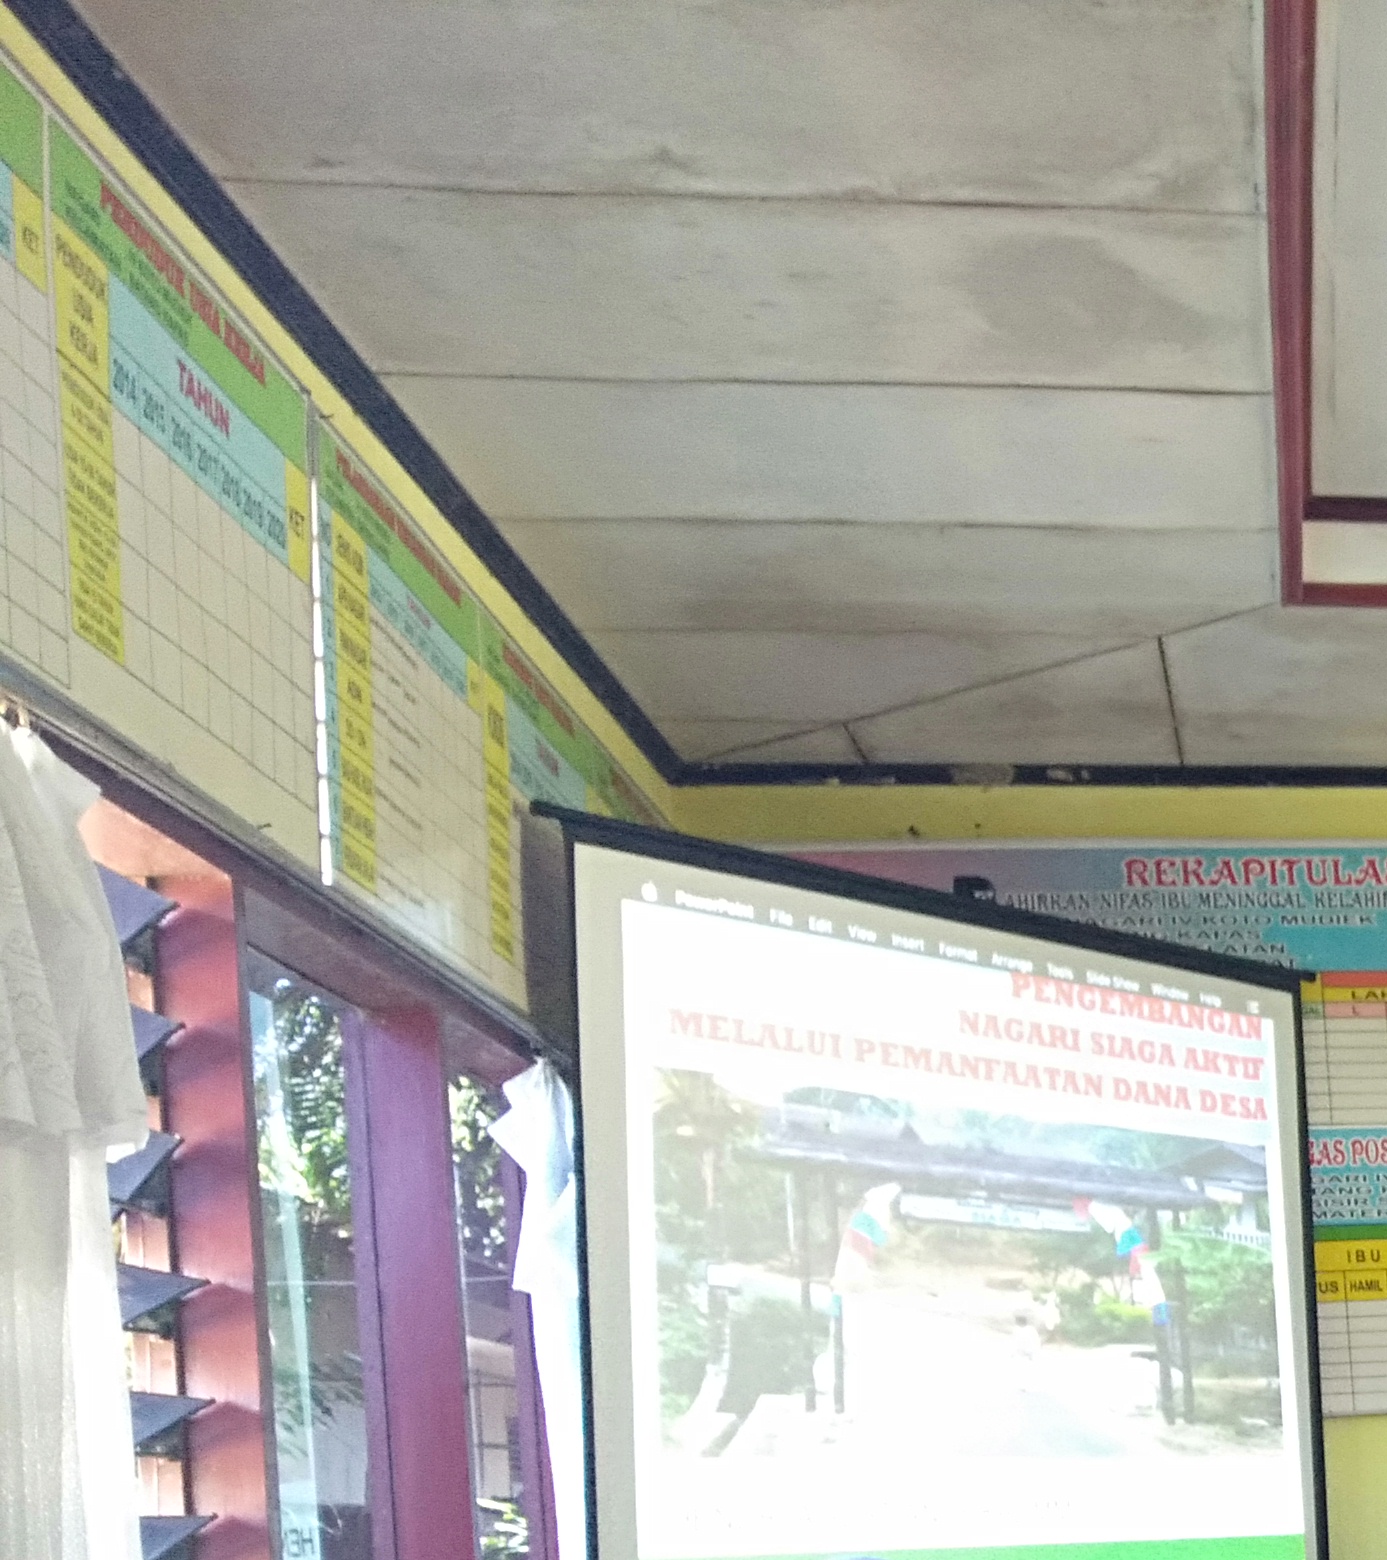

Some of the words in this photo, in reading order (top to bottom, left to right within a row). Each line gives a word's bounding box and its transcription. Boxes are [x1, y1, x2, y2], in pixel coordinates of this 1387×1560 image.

[1004, 892, 1090, 911] AHIRKAN
[668, 1007, 843, 1059] MELALUI
[1112, 1076, 1192, 1111] DANA
[1199, 1088, 1268, 1121] DESA
[958, 1009, 1081, 1053] NAGARI
[1090, 1031, 1176, 1068] SIAGA
